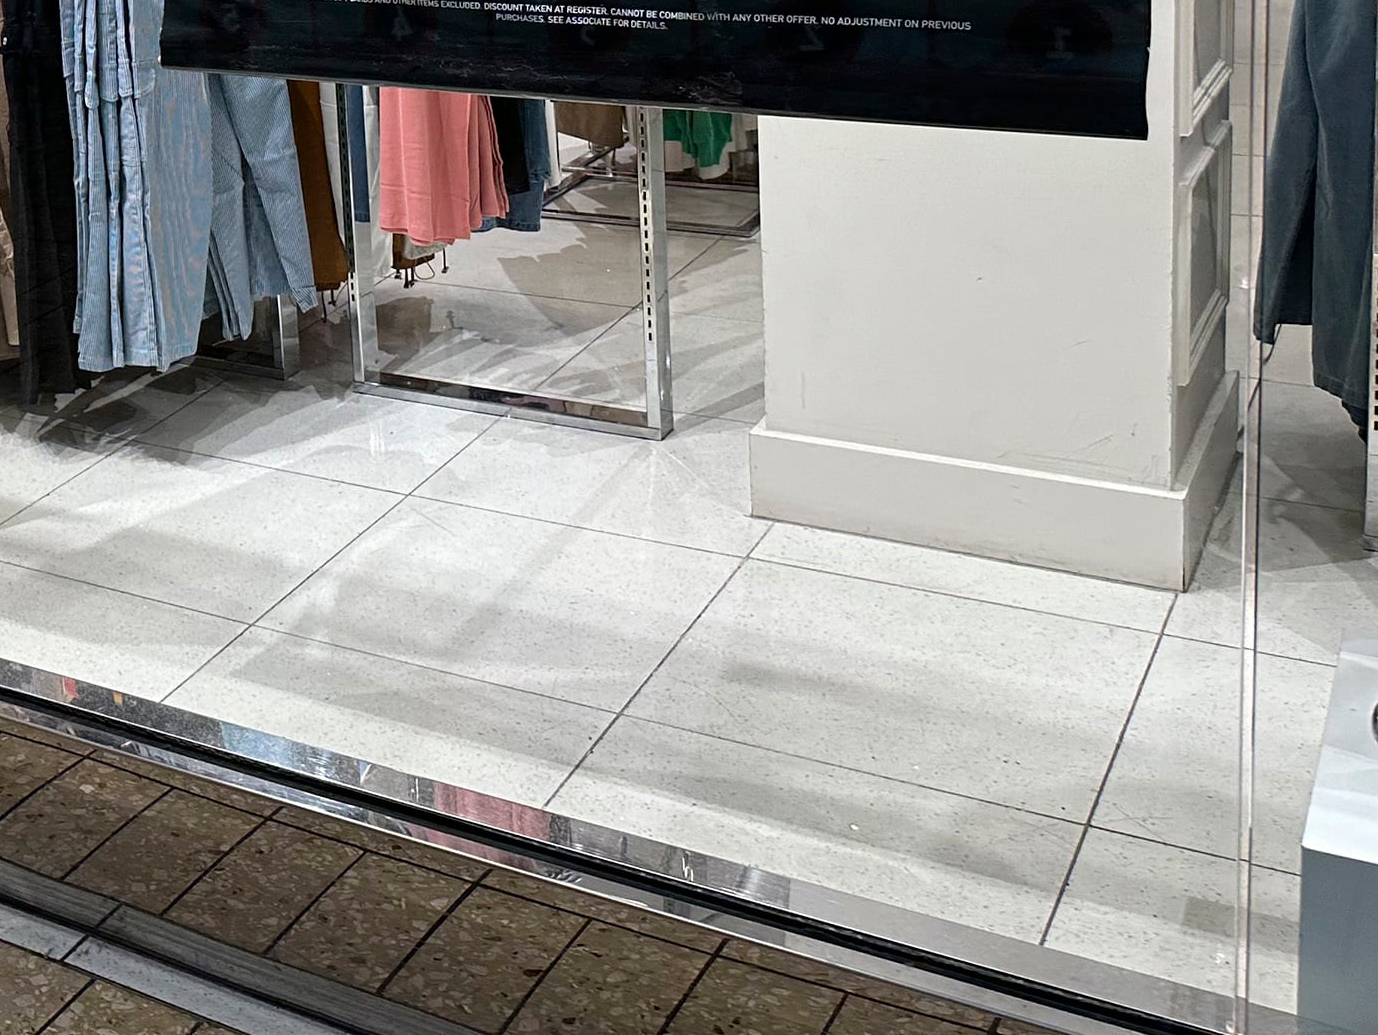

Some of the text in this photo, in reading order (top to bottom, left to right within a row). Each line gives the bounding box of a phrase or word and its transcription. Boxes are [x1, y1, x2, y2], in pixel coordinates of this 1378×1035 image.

[484, 2, 524, 12] DISCOUNT
[525, 4, 553, 13] TAKEN
[554, 5, 565, 14] AT
[610, 7, 644, 18] CANNOT
[646, 10, 658, 19] BE
[659, 10, 705, 21] COMBINED
[706, 12, 730, 22] WITH
[732, 13, 752, 22] ANY
[753, 14, 785, 24] OTHER
[786, 15, 819, 25] OFFER.
[821, 16, 835, 25] NO
[837, 17, 902, 28] ADJUSTMENT
[904, 19, 919, 28] ON
[921, 19, 972, 31] PREVIOUS
[547, 15, 564, 25] SEE
[565, 16, 611, 27] ASSOCIATE
[613, 18, 629, 28] FOR
[630, 20, 669, 30] DETAILS.
